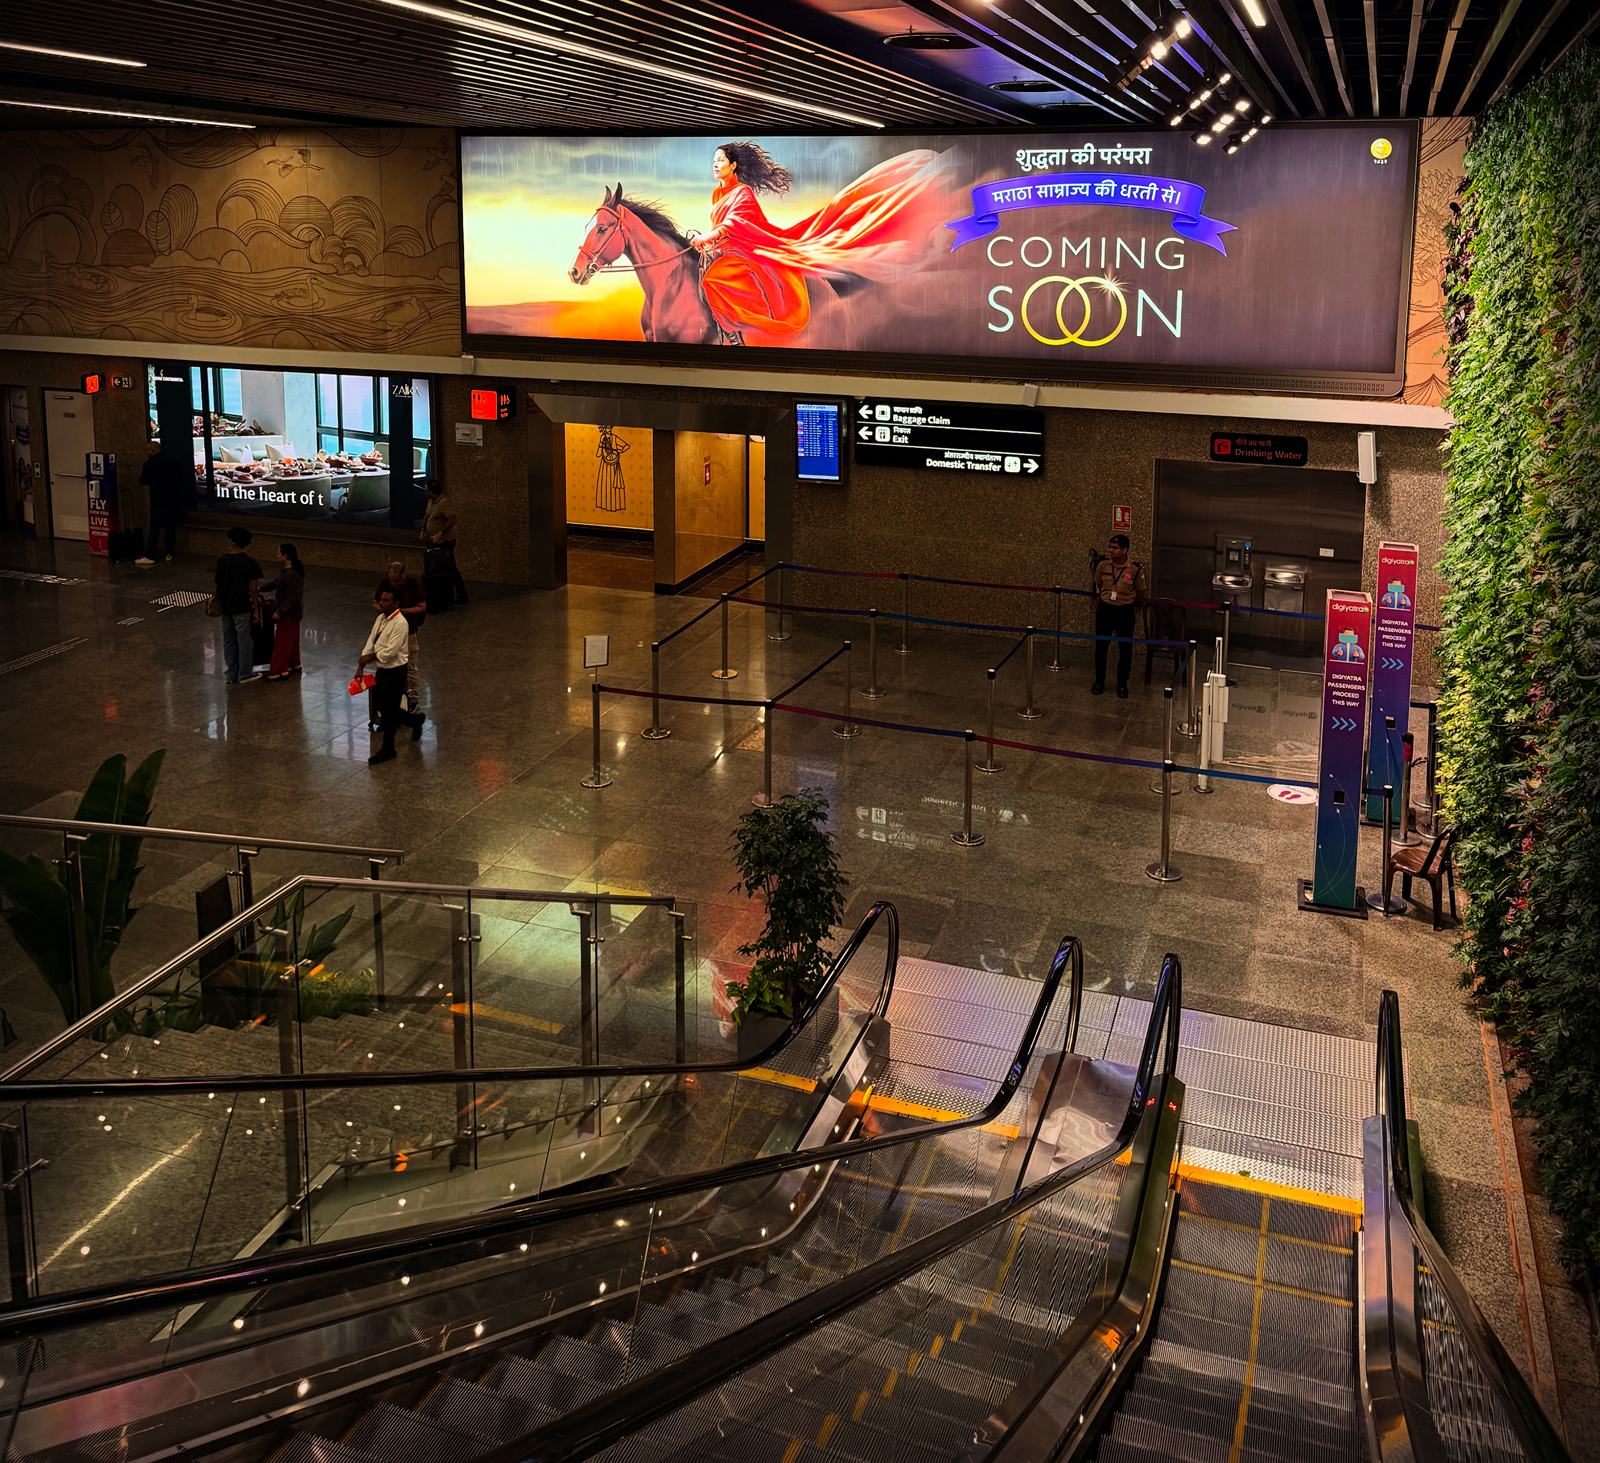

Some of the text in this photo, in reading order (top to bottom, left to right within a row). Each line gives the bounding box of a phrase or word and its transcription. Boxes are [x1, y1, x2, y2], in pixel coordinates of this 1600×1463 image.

[1016, 142, 1153, 172] शुद्धता की परंपरा
[992, 186, 1033, 203] मराठा
[1035, 183, 1092, 199] साम्राज्य
[1093, 180, 1118, 198] की
[1120, 182, 1159, 201] धरती
[987, 236, 1185, 270] COMING
[988, 275, 1183, 347] SOON
[893, 414, 951, 426] Baggage Claim
[892, 435, 909, 443] Exit
[1235, 448, 1303, 460] Drinking Water
[926, 458, 1002, 471] Domestic Transfer
[216, 483, 324, 506] In the heart of t
[90, 499, 107, 510] FLY
[90, 516, 108, 526] LIVE
[1382, 634, 1406, 642] PROCEED
[1332, 673, 1362, 682] DIGIYATRA
[1327, 682, 1366, 691] PASSENGERS
[1332, 690, 1360, 699] PROCEED
